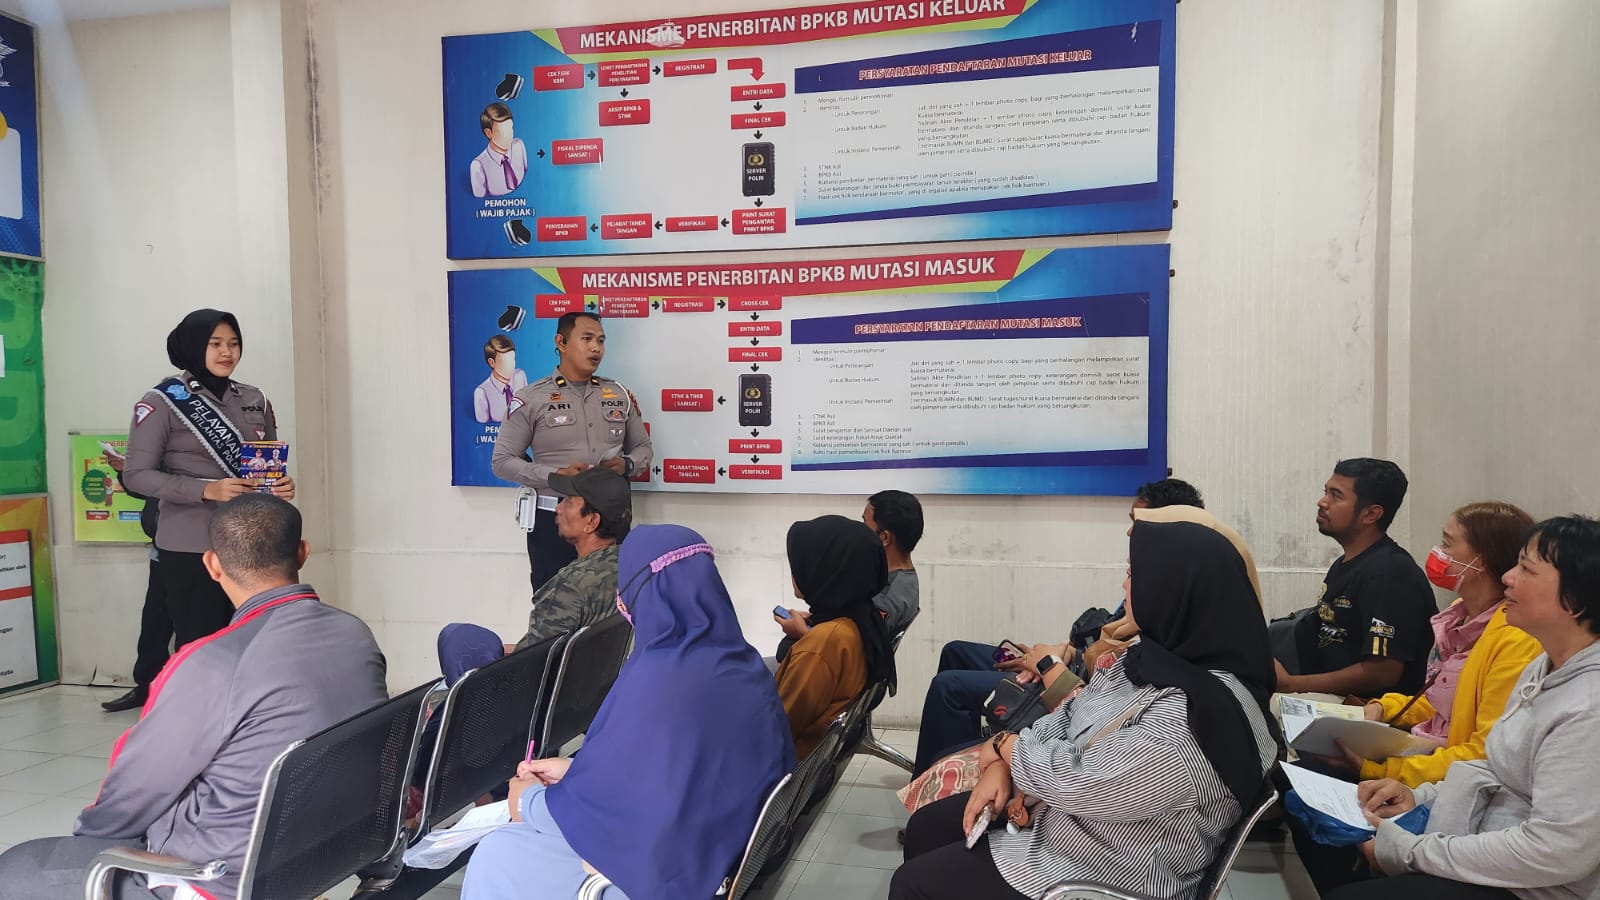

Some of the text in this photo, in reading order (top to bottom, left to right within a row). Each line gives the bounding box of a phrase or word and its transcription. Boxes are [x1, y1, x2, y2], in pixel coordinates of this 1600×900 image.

[580, 0, 1006, 49] MEKANISME PENERBITAN BPKB MUTASI KELUAR
[859, 50, 1092, 80] PERSYARATAN PENDAFTARAN MUTASI KELUAR
[485, 199, 526, 207] PEMOHON
[582, 257, 996, 288] MEKANISME PENERBITAN BPKB MUTASI MASUK
[855, 317, 1082, 335] PERSYARATAN PENDAFTARAN MUTASI MASUK
[548, 403, 571, 412] ARI
[189, 400, 241, 459] PELAYANAN
[190, 412, 241, 472] DITLANTAS POLDA
